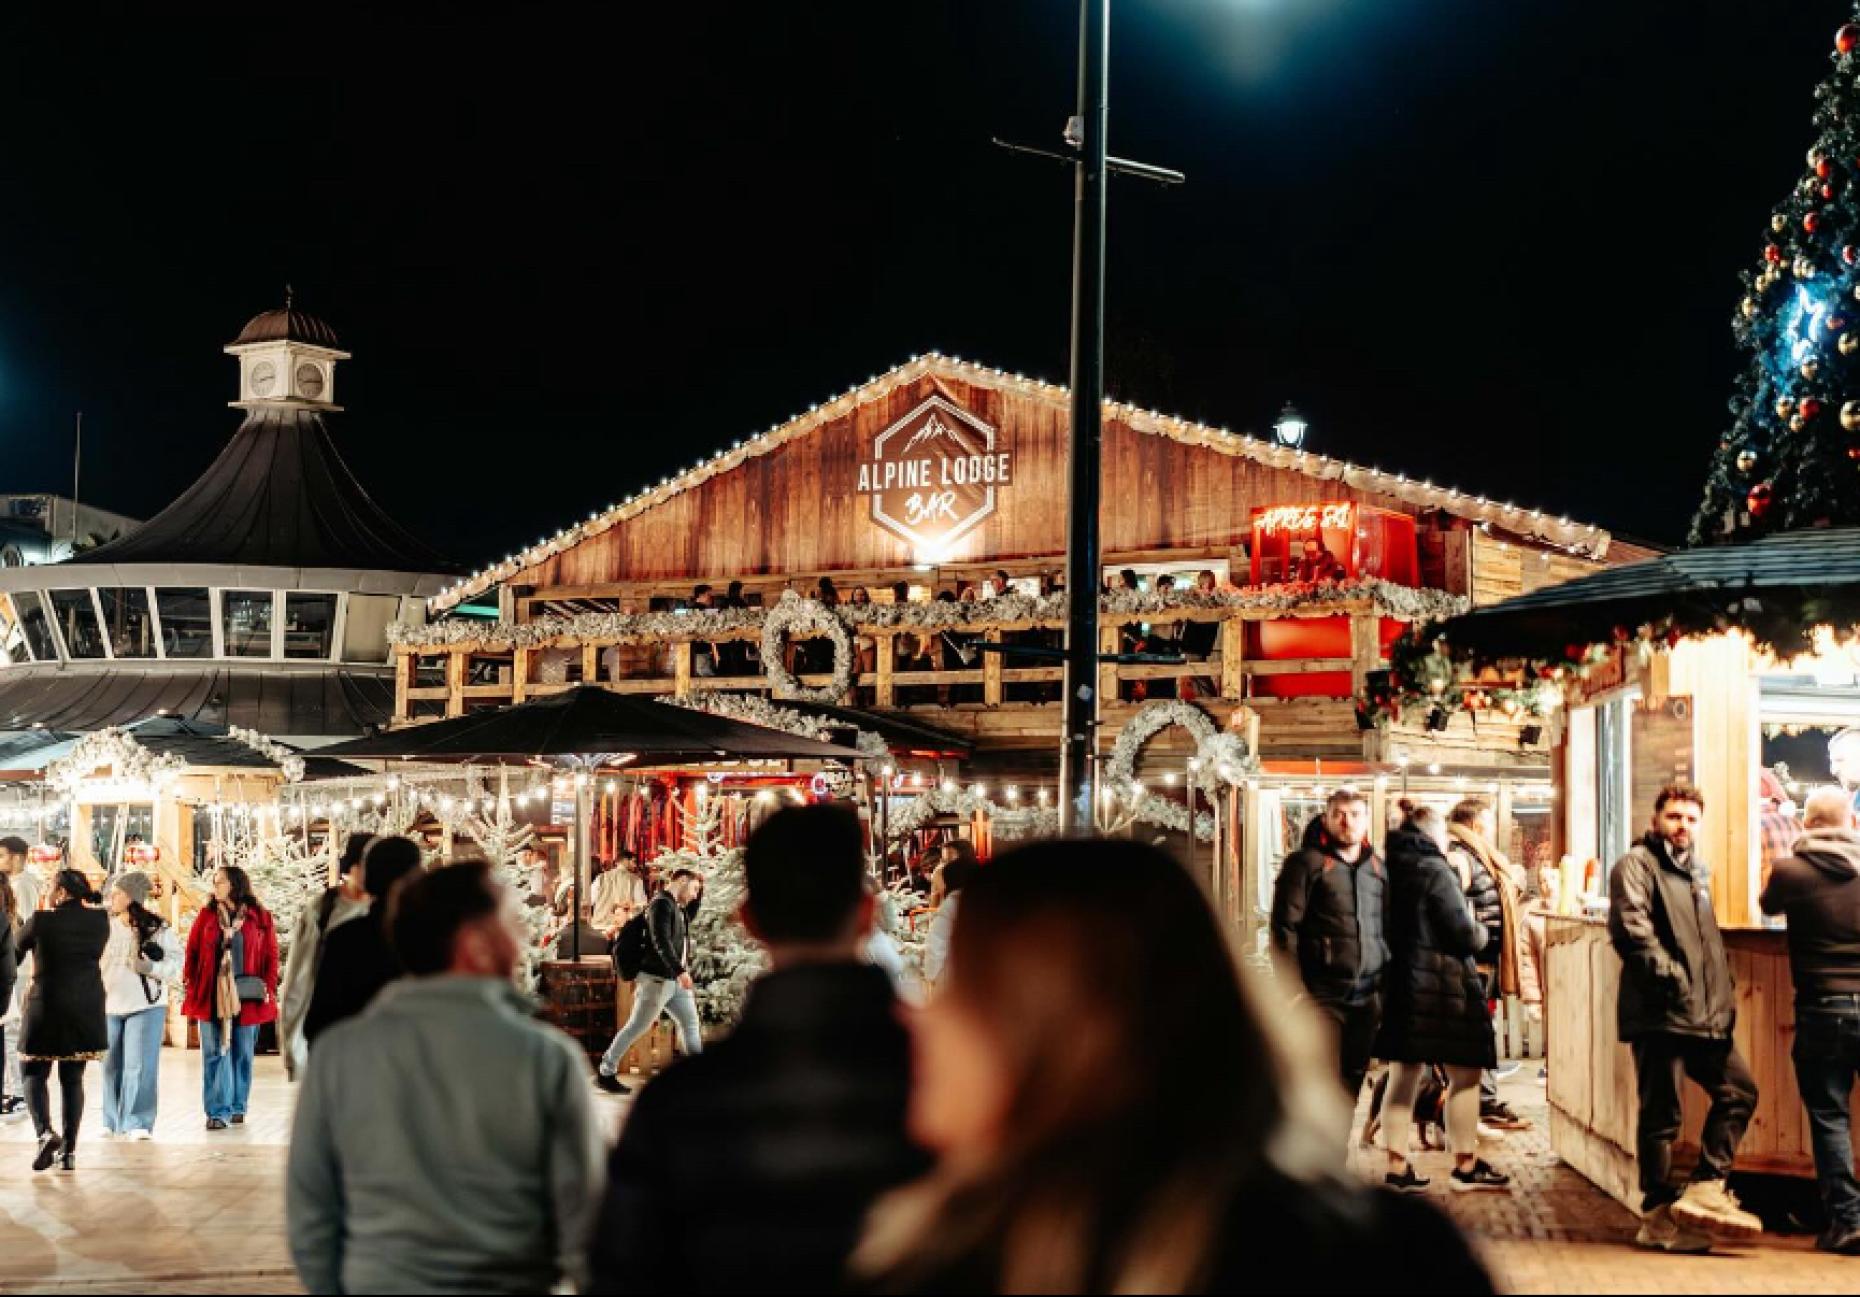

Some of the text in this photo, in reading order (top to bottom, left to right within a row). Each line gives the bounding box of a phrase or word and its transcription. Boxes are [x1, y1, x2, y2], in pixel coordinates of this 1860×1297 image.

[857, 453, 1010, 491] ALPINE LODGE
[904, 490, 960, 525] BAR
[1320, 502, 1350, 529] SKI
